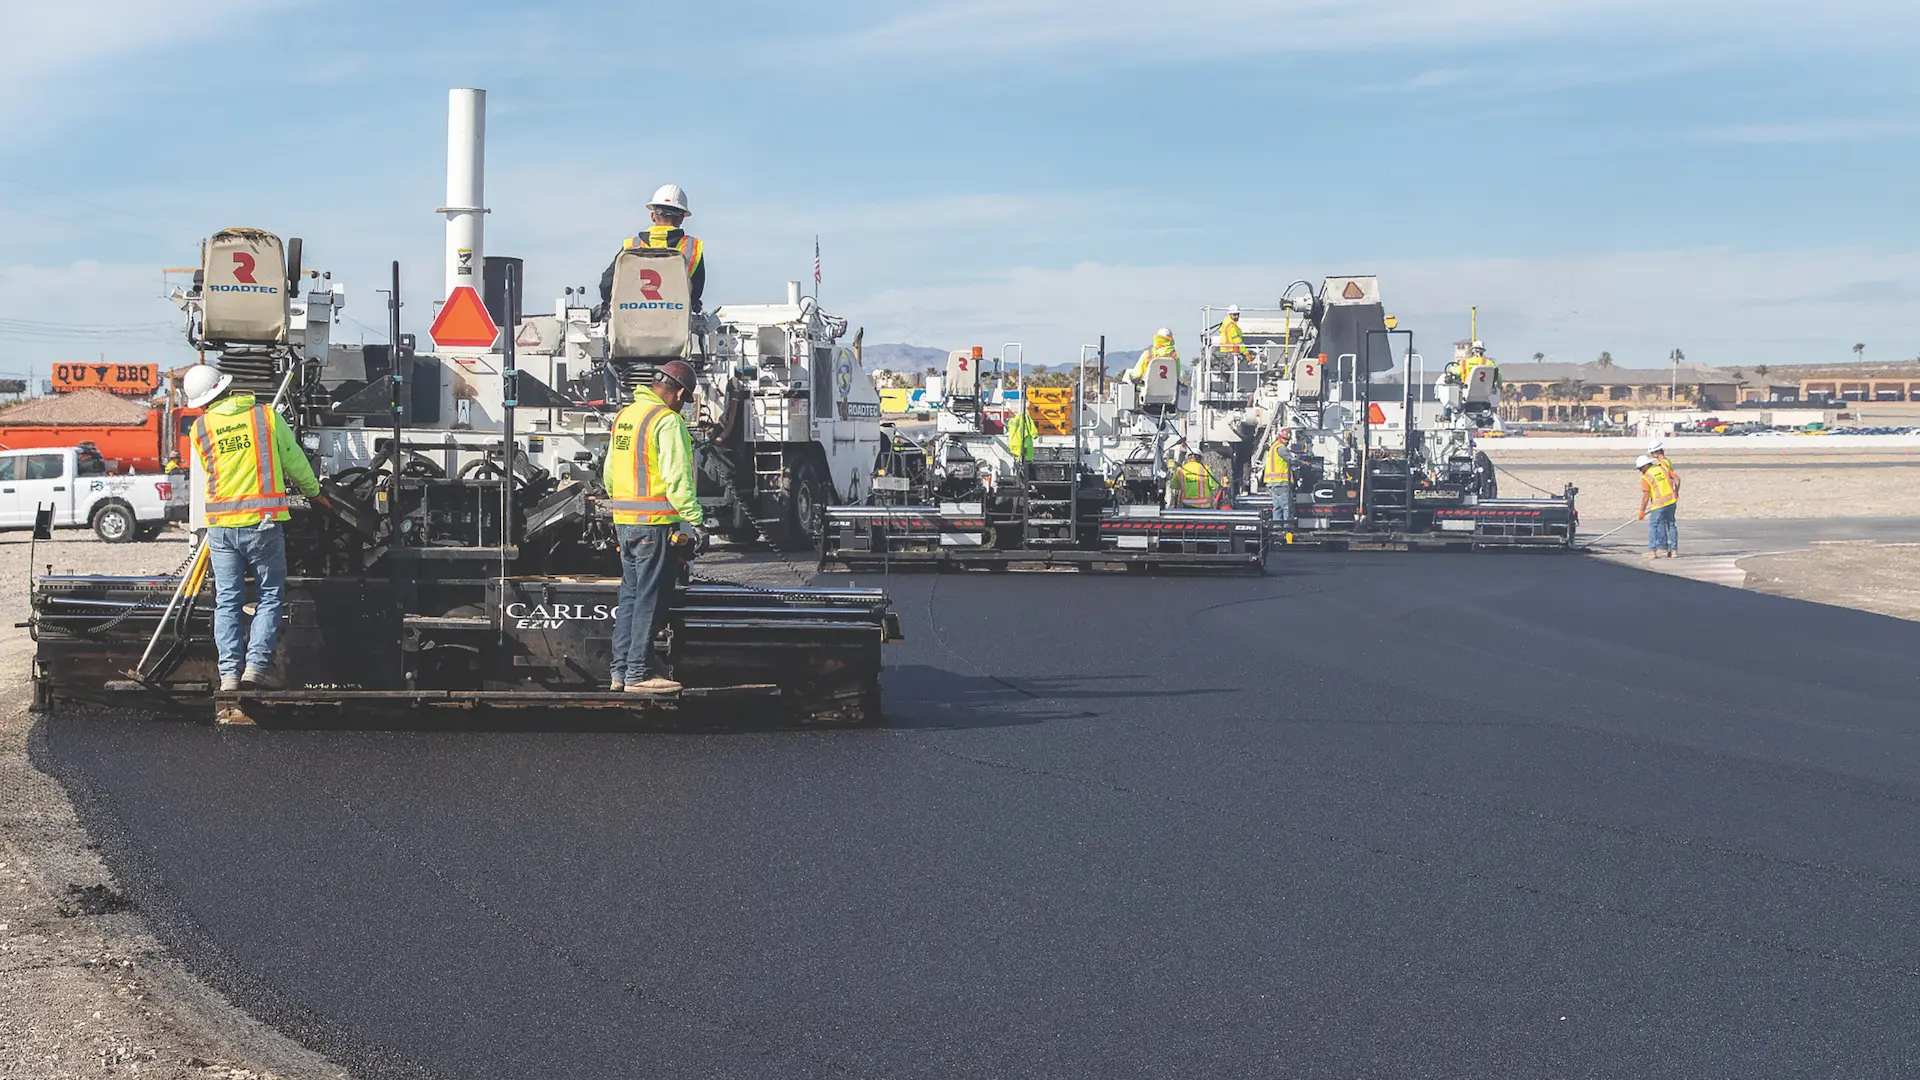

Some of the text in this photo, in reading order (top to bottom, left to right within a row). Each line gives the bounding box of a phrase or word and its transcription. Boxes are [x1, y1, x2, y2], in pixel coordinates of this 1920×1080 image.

[209, 284, 278, 294] ROADTEC
[619, 302, 684, 310] ROADTEC
[116, 365, 150, 386] BBQ
[847, 404, 878, 416] ROADTEC
[516, 620, 564, 629] EZIV
